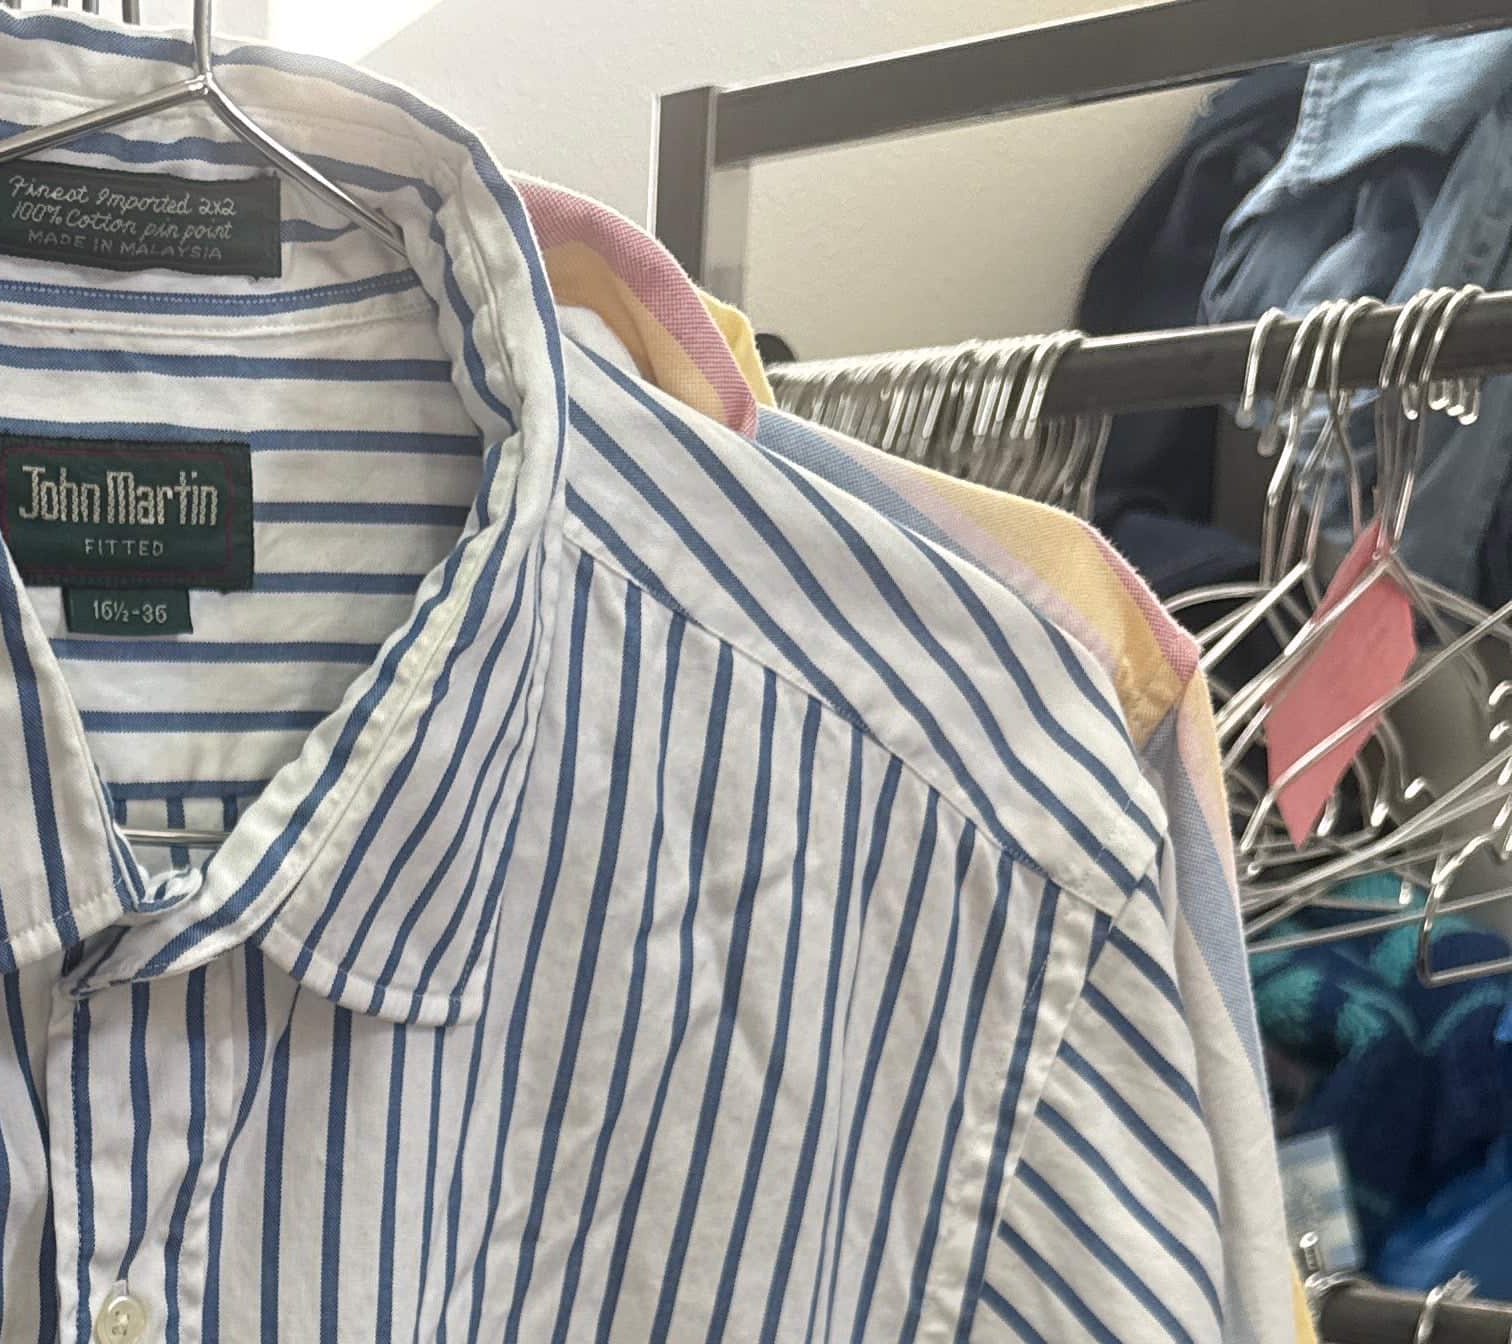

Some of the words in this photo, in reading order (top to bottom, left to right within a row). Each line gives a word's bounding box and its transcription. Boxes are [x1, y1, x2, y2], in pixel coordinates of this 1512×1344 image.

[9, 176, 90, 205] Finest
[12, 201, 63, 225] 100%
[67, 210, 136, 235] Cotton
[29, 230, 85, 249] MADE
[94, 238, 114, 253] IN
[120, 242, 223, 261] MALAYSIA
[19, 465, 101, 523] John
[107, 471, 218, 526] Martin
[85, 538, 164, 557] FITTED
